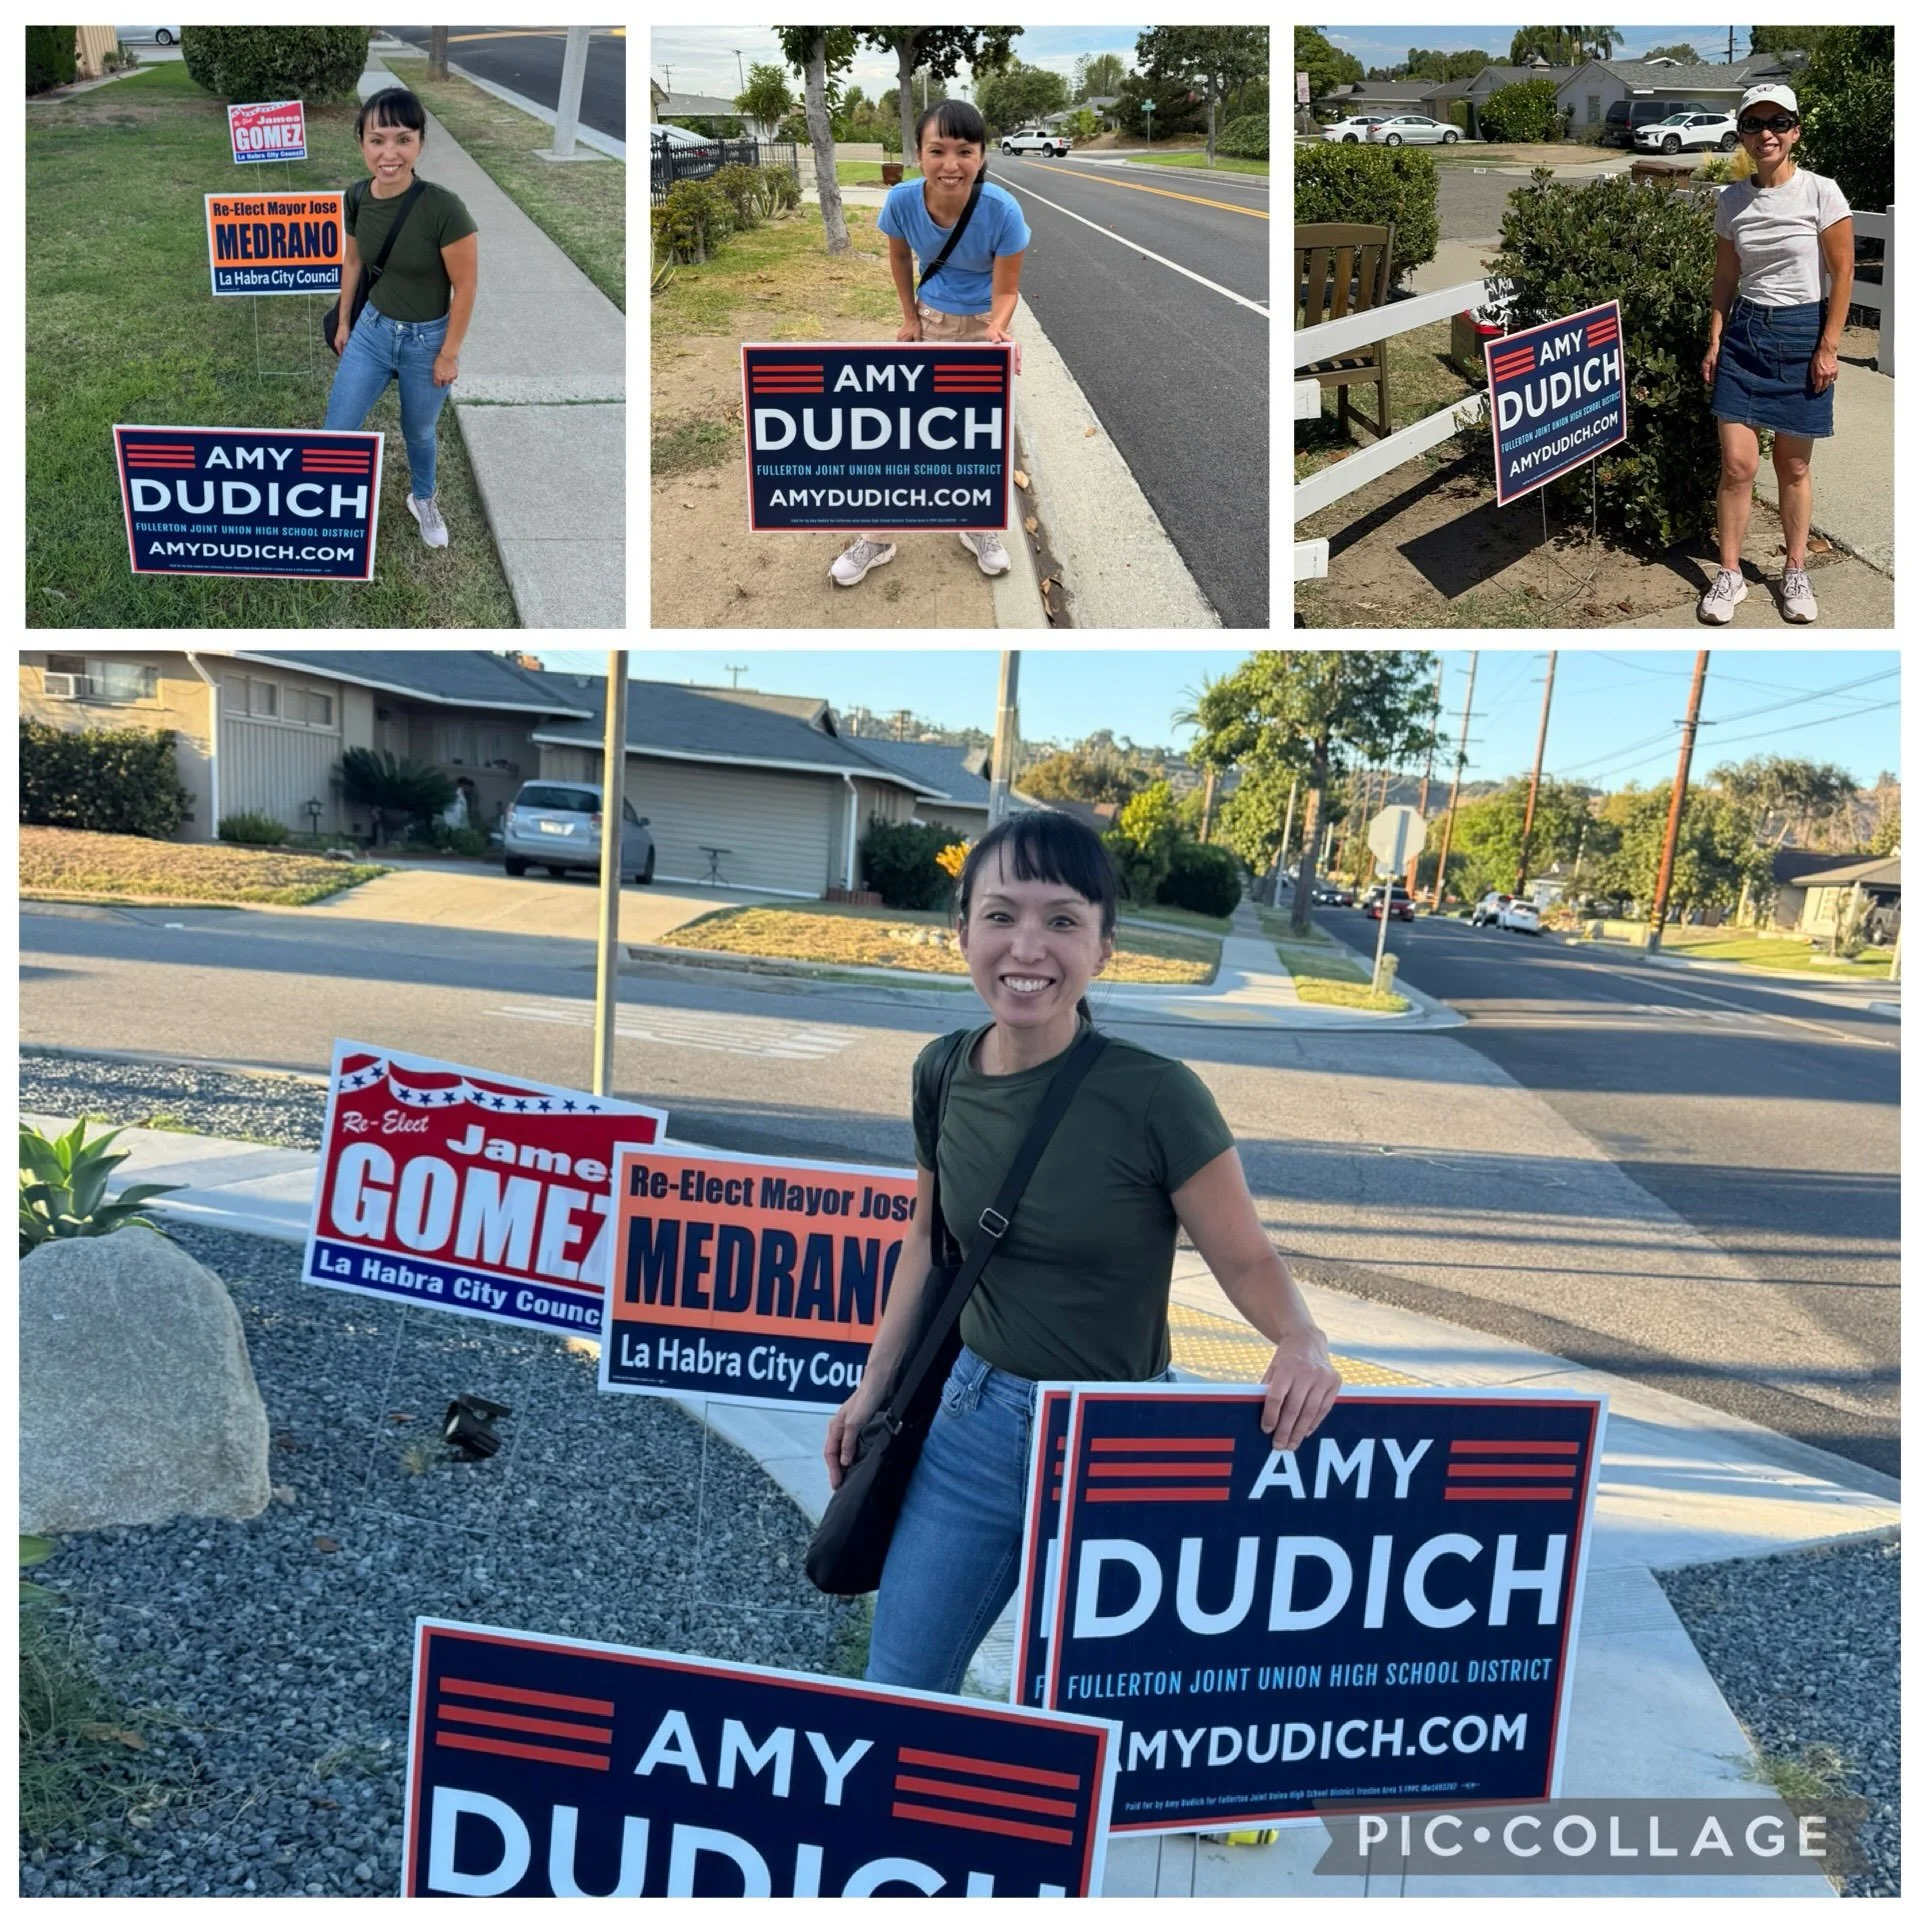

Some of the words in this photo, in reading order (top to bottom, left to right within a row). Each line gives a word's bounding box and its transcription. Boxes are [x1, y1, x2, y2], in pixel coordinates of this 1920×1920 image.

[235, 123, 302, 150] GOMEZ
[257, 115, 300, 125] James
[213, 202, 265, 216] Re-Elect
[268, 201, 306, 216] Mayor
[309, 201, 336, 214] Jose
[216, 221, 338, 260] MEDRANO
[219, 272, 232, 285] La
[234, 270, 269, 285] Habra
[271, 270, 295, 287] City
[297, 268, 339, 284] Council
[1539, 329, 1583, 366] AMY
[833, 364, 925, 392] AMY
[1497, 348, 1621, 432] DUDICH
[754, 406, 1002, 450] DUDICH
[1501, 432, 1533, 454] FULLERTON
[1534, 424, 1551, 438] JOINT
[1552, 417, 1569, 431] UNION
[1569, 411, 1583, 423] HIGH
[1583, 401, 1602, 417] SCHOOL
[1601, 390, 1621, 407] DISTRICT
[204, 446, 294, 471] AMY
[1510, 411, 1618, 477] AMYDUDICH.COM
[757, 465, 812, 476] FULLERTON
[815, 464, 845, 476] JOINT
[849, 465, 882, 476] UNION
[885, 464, 911, 475] HIGH
[914, 464, 953, 475] SCHOOL
[956, 464, 1002, 475] DISTRICT
[130, 478, 368, 519] DUDICH
[769, 489, 991, 507] AMYDUDICH.COM
[135, 522, 187, 533] FULLERTON
[190, 524, 218, 534] JOINT
[221, 525, 252, 535] UNION
[256, 526, 279, 536] HIGH
[282, 527, 318, 537] SCHOOL
[322, 528, 365, 538] DISTRICT
[149, 541, 354, 561] AMYDUDICH.COM
[342, 1110, 430, 1135] Re-Elect
[446, 1124, 612, 1183] Jame
[630, 1165, 754, 1209] Re-Elect
[760, 1178, 854, 1219] Mayor
[859, 1186, 917, 1222] Jos
[319, 1250, 351, 1276] La
[362, 1257, 444, 1293] Habra
[454, 1276, 508, 1311] City
[516, 1290, 601, 1328] Counc
[620, 1334, 650, 1369] La
[658, 1339, 742, 1378] Habra
[748, 1346, 805, 1393] City
[1248, 1438, 1434, 1499] AMY
[1073, 1533, 1568, 1639] DUDICH
[1068, 1672, 1181, 1699] FULLERTON
[1189, 1668, 1251, 1694] JOINT
[1258, 1665, 1321, 1690] UNION
[1330, 1663, 1378, 1687] HIGH
[1385, 1661, 1460, 1684] SCHOOL
[1467, 1658, 1552, 1683] DISTRICT
[632, 1708, 875, 1807] AMY
[1117, 1713, 1528, 1772] MYDUDICH.COM
[427, 1785, 1066, 1897] DUDI
